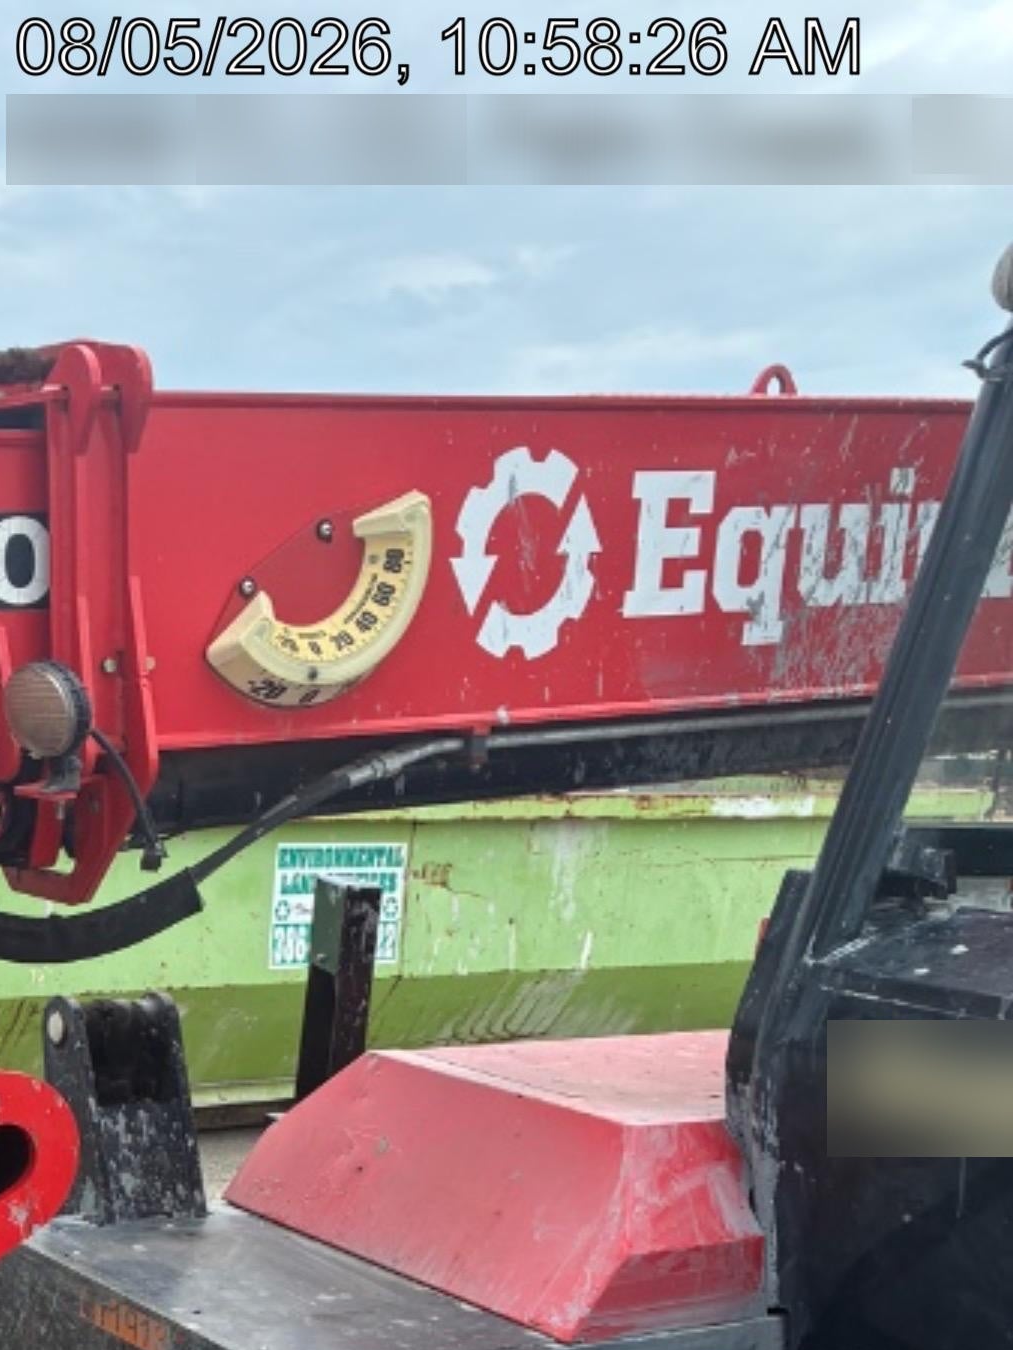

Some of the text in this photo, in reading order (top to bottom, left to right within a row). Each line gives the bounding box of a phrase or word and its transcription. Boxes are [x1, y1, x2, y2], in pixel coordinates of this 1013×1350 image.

[383, 548, 406, 573] 80
[622, 470, 1013, 648] Equi
[372, 581, 396, 607] 60
[356, 611, 379, 633] 40
